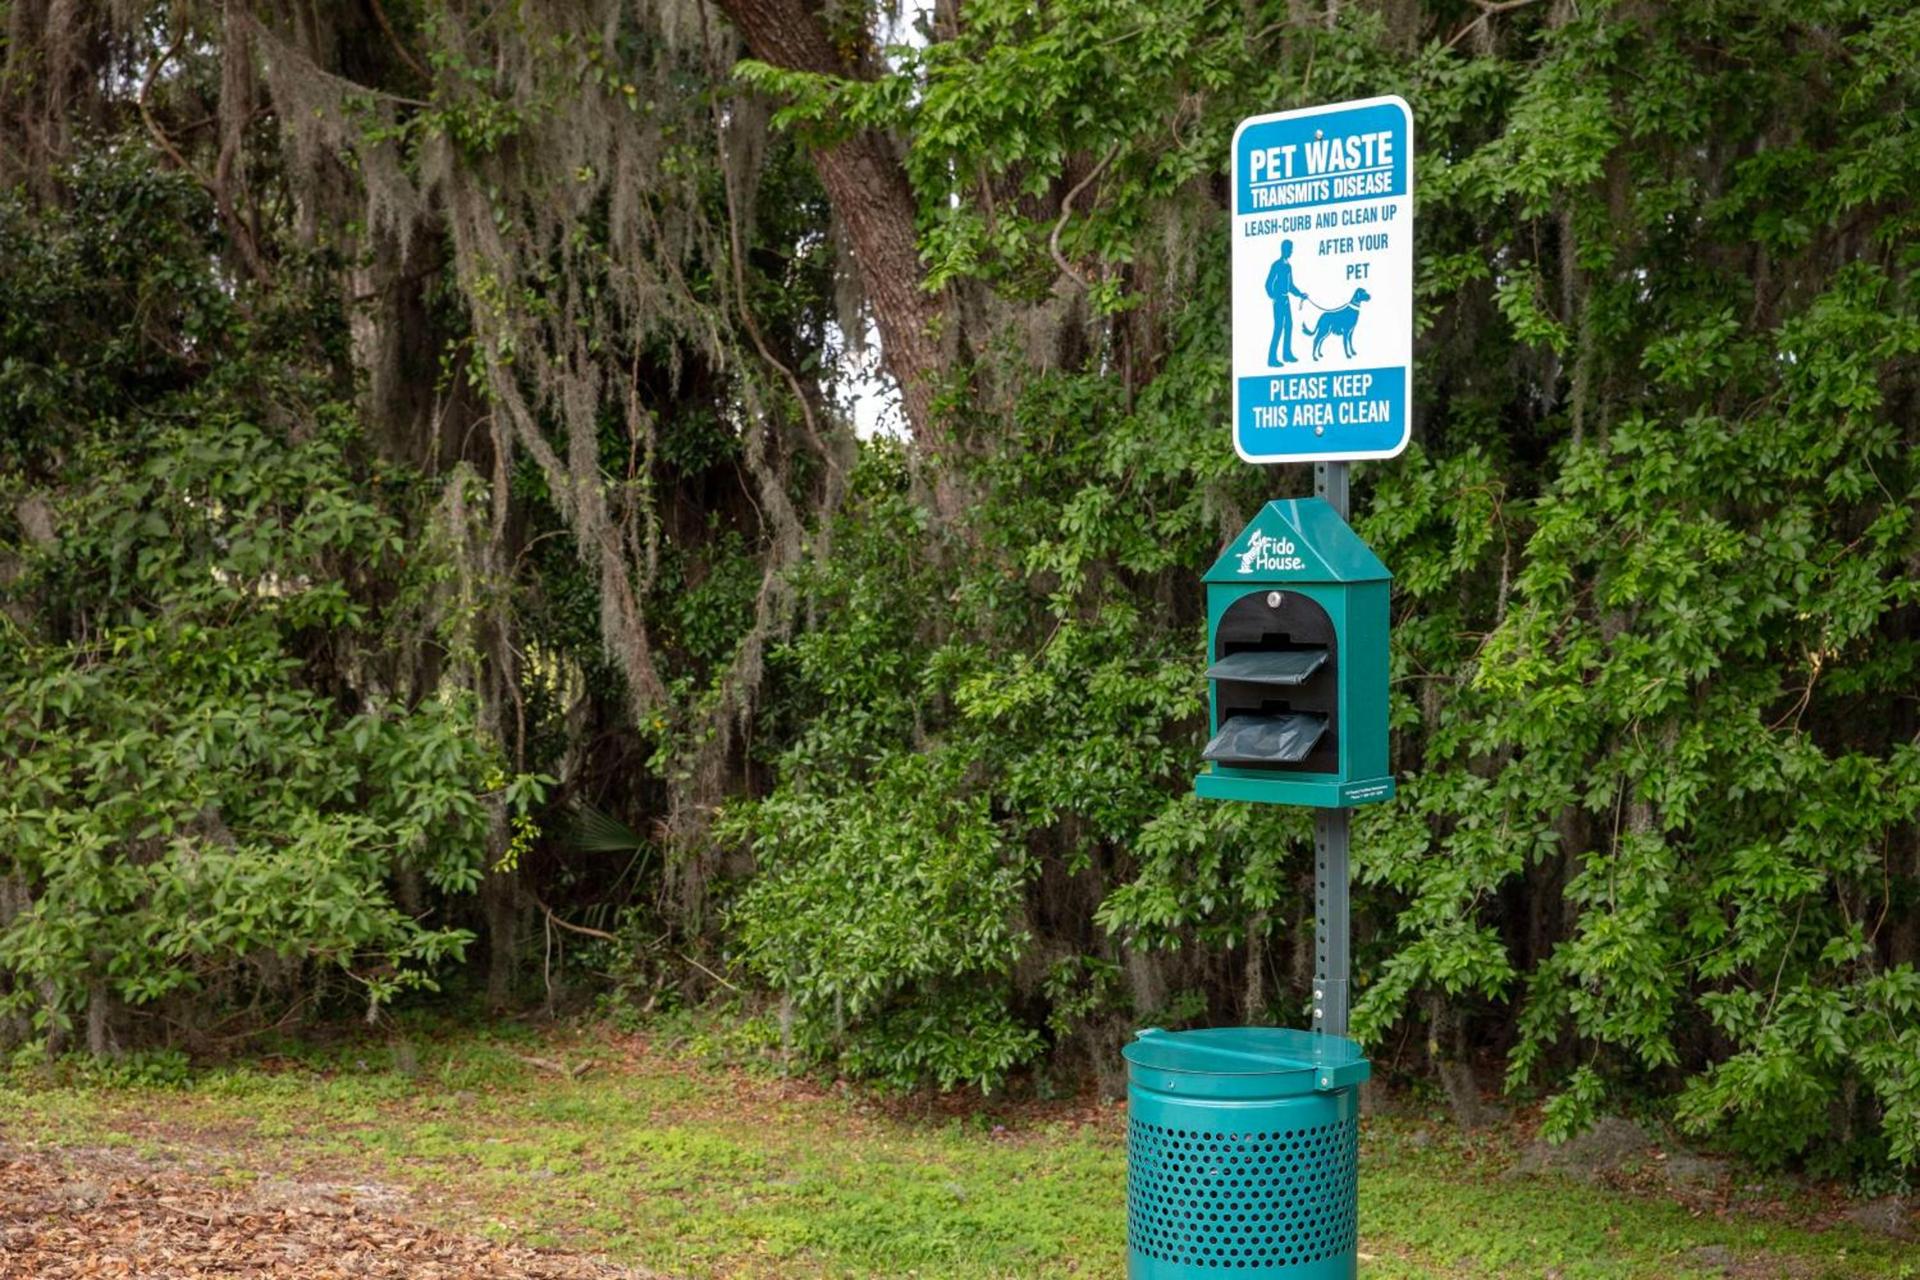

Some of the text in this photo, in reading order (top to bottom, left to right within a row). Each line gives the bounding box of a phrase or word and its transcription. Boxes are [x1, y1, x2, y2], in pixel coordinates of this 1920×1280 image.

[1250, 130, 1394, 182] PET WASTE
[1251, 171, 1393, 209] TRANSMITS DISEASE
[1245, 204, 1397, 237] LEASH-CURB AND CLEAN UP
[1318, 233, 1389, 256] AFTER YOUR
[1346, 262, 1370, 280] PET
[1270, 373, 1373, 402] PLEASE KEEP
[1252, 400, 1390, 428] THIS AREA CLEAN
[1262, 536, 1295, 555] Fido
